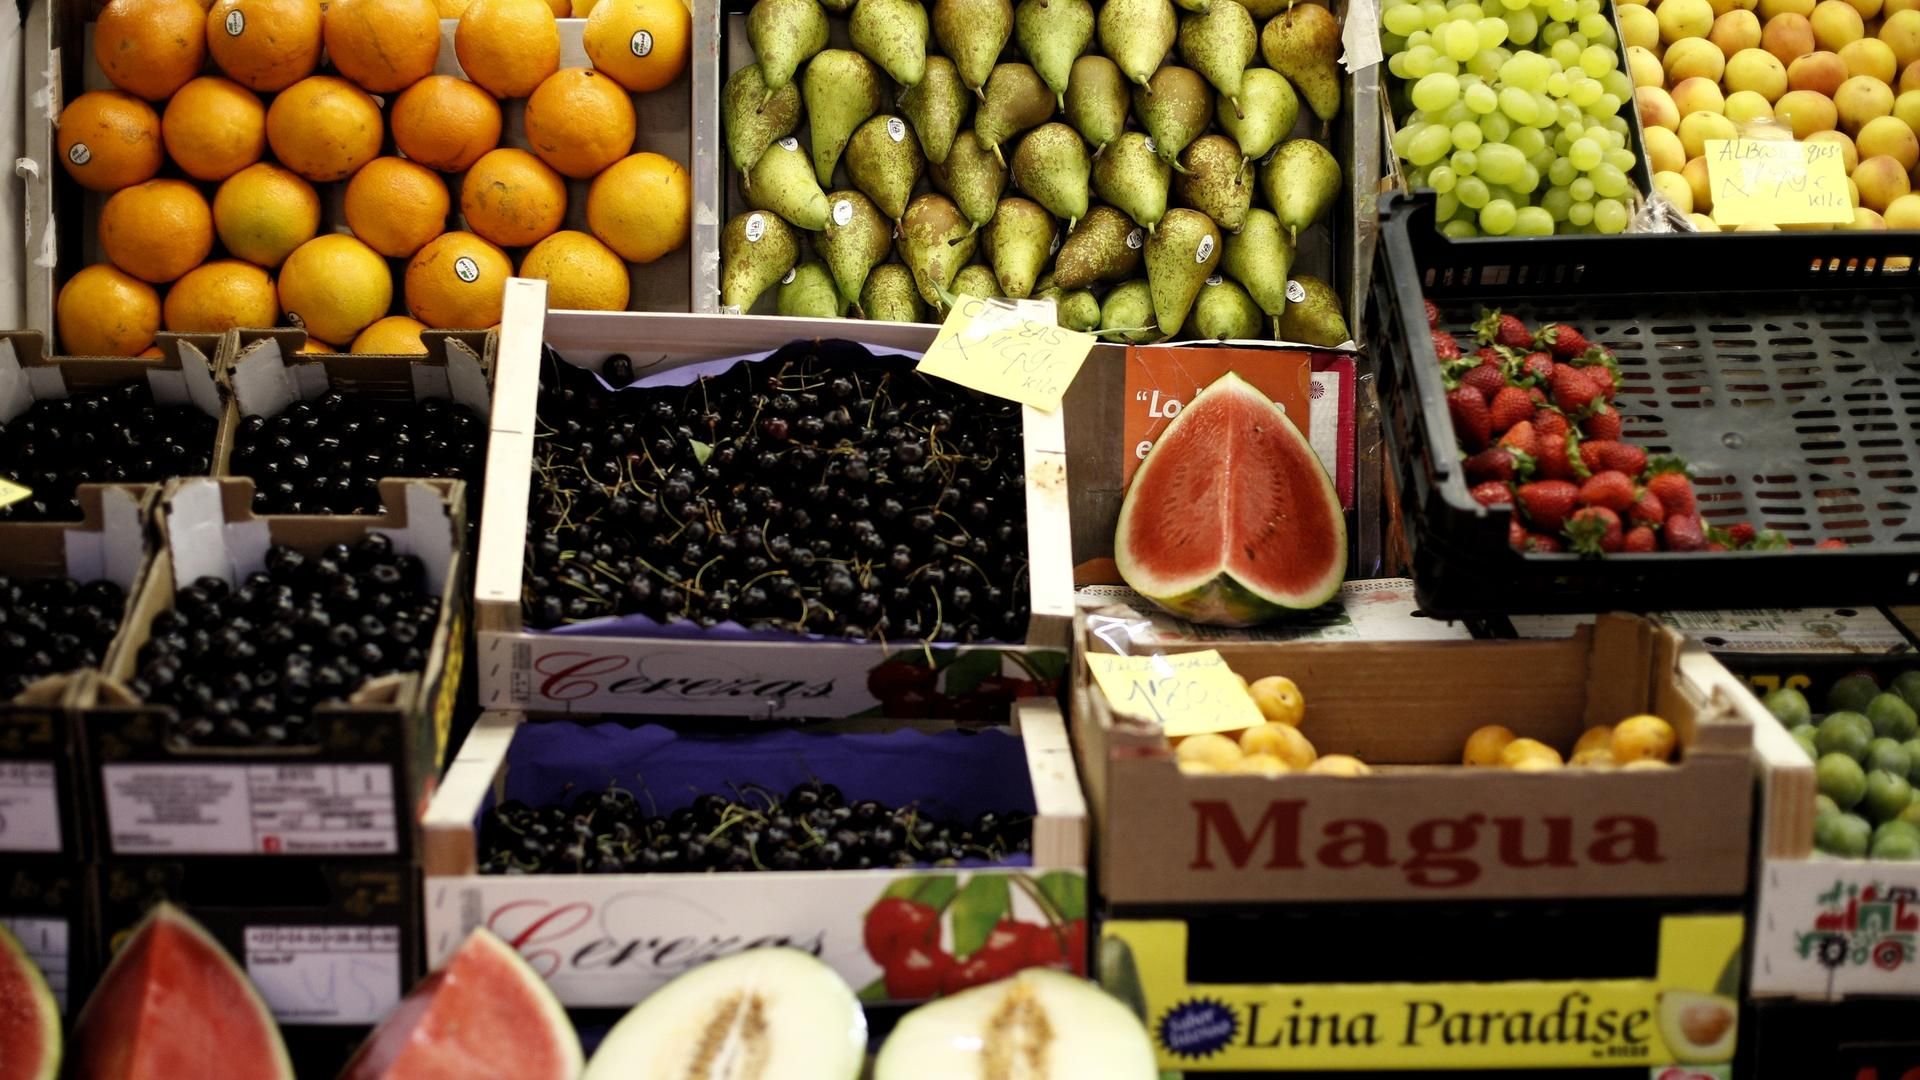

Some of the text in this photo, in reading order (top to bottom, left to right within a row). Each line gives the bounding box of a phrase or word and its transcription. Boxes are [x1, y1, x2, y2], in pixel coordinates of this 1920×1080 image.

[534, 651, 834, 702] Cerezas
[1188, 799, 1667, 888] Magua
[1241, 991, 1651, 1049] Lina Paradise
